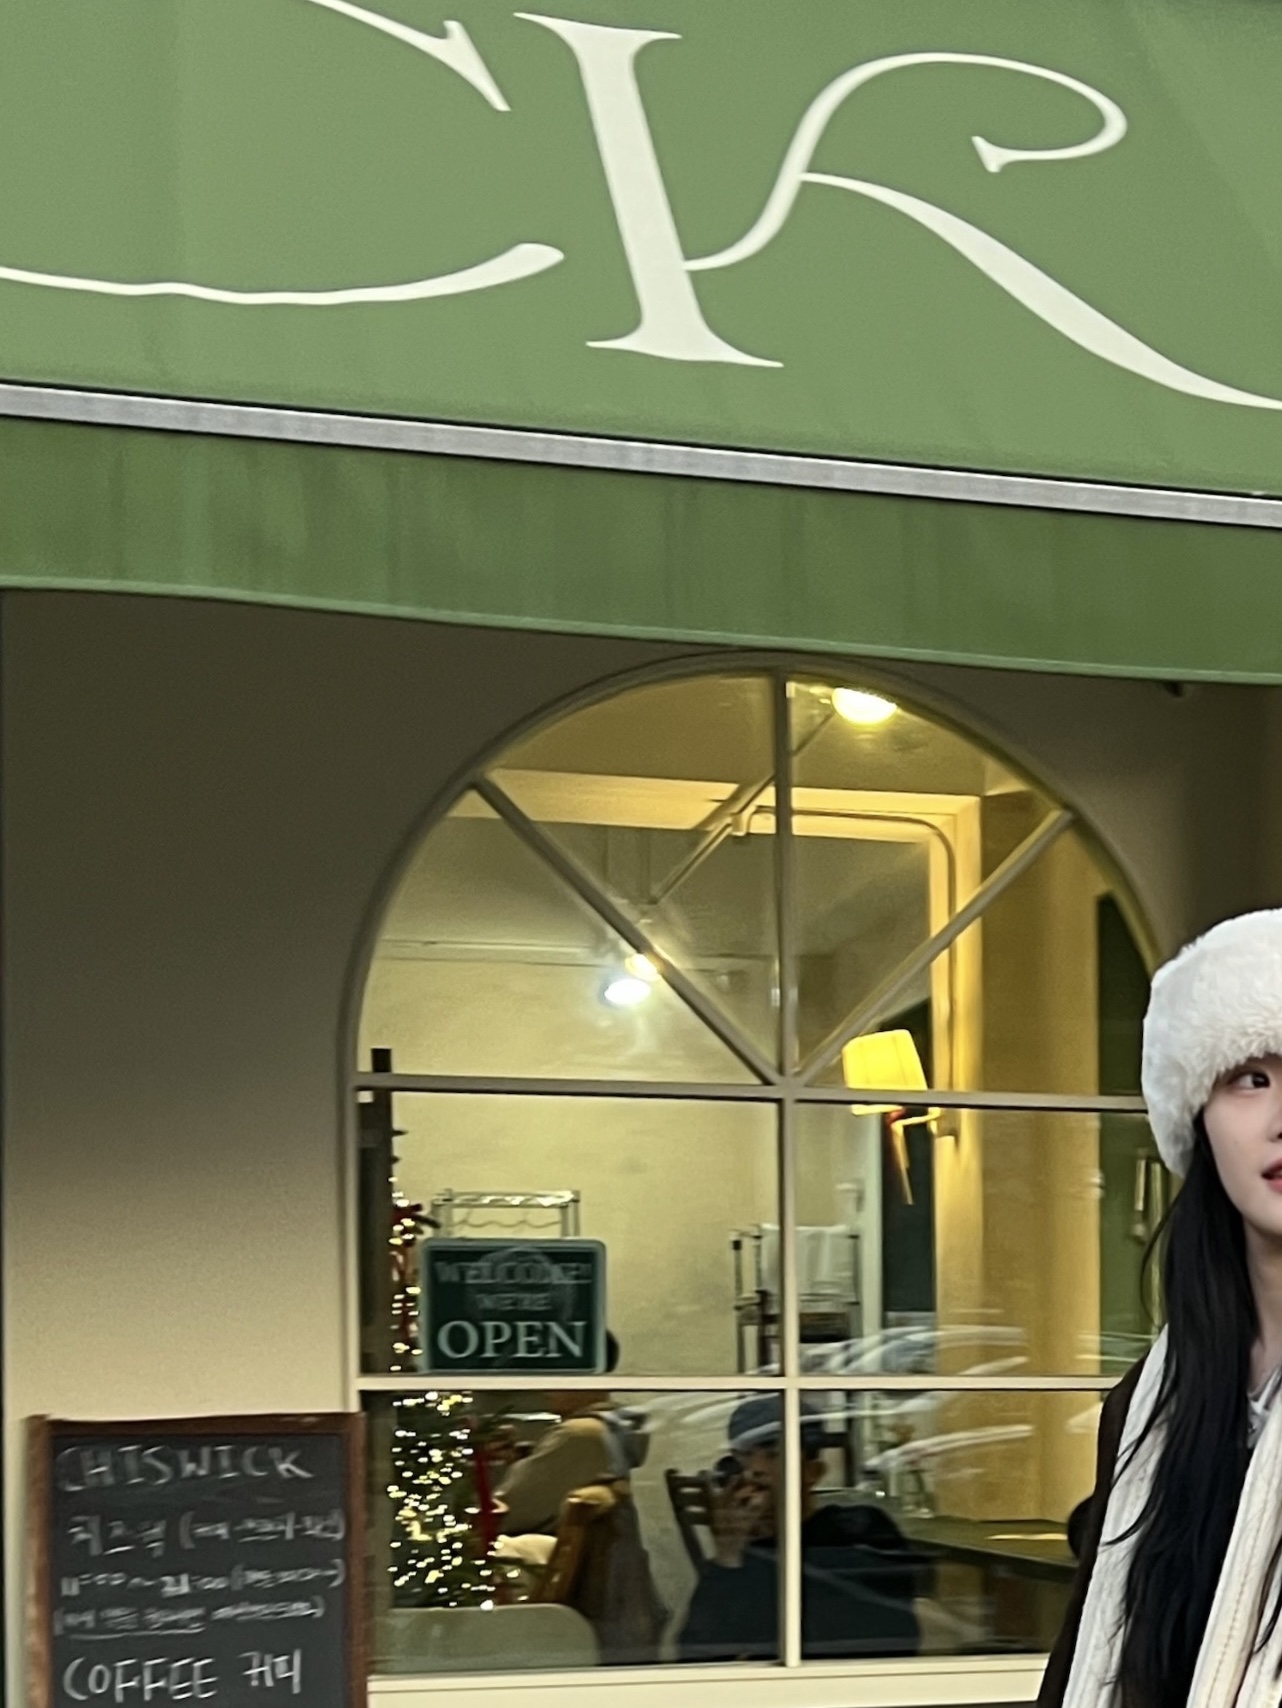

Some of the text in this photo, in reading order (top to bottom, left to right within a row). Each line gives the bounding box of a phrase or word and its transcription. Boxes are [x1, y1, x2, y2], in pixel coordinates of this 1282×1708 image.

[437, 1320, 587, 1359] OPEN
[57, 1444, 314, 1491] CHISWICK
[63, 1657, 218, 1702] COFFEE
